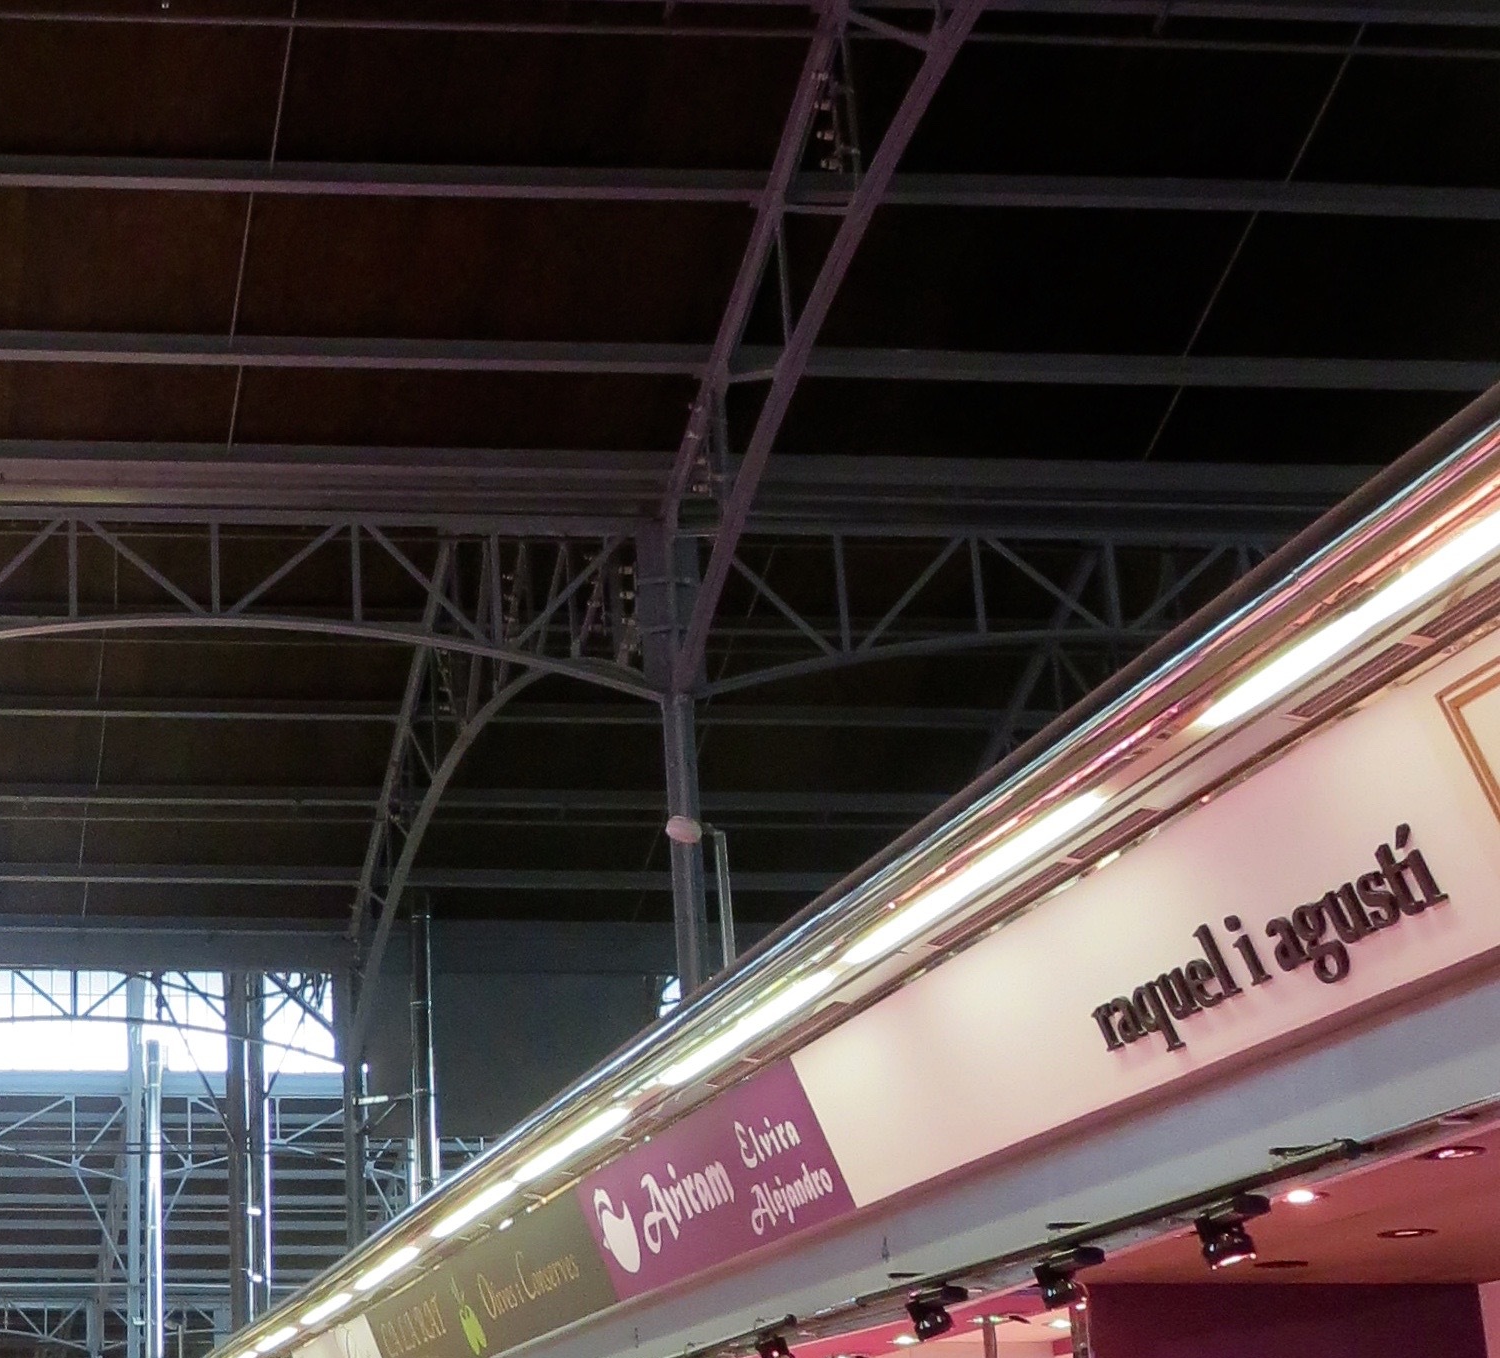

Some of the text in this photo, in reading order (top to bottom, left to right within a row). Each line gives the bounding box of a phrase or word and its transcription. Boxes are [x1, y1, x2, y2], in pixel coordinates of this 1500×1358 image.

[1091, 823, 1450, 1052] raquel i agustí
[735, 1117, 802, 1169] Elvira
[640, 1159, 736, 1254] Aviram
[751, 1162, 834, 1236] Alejandro
